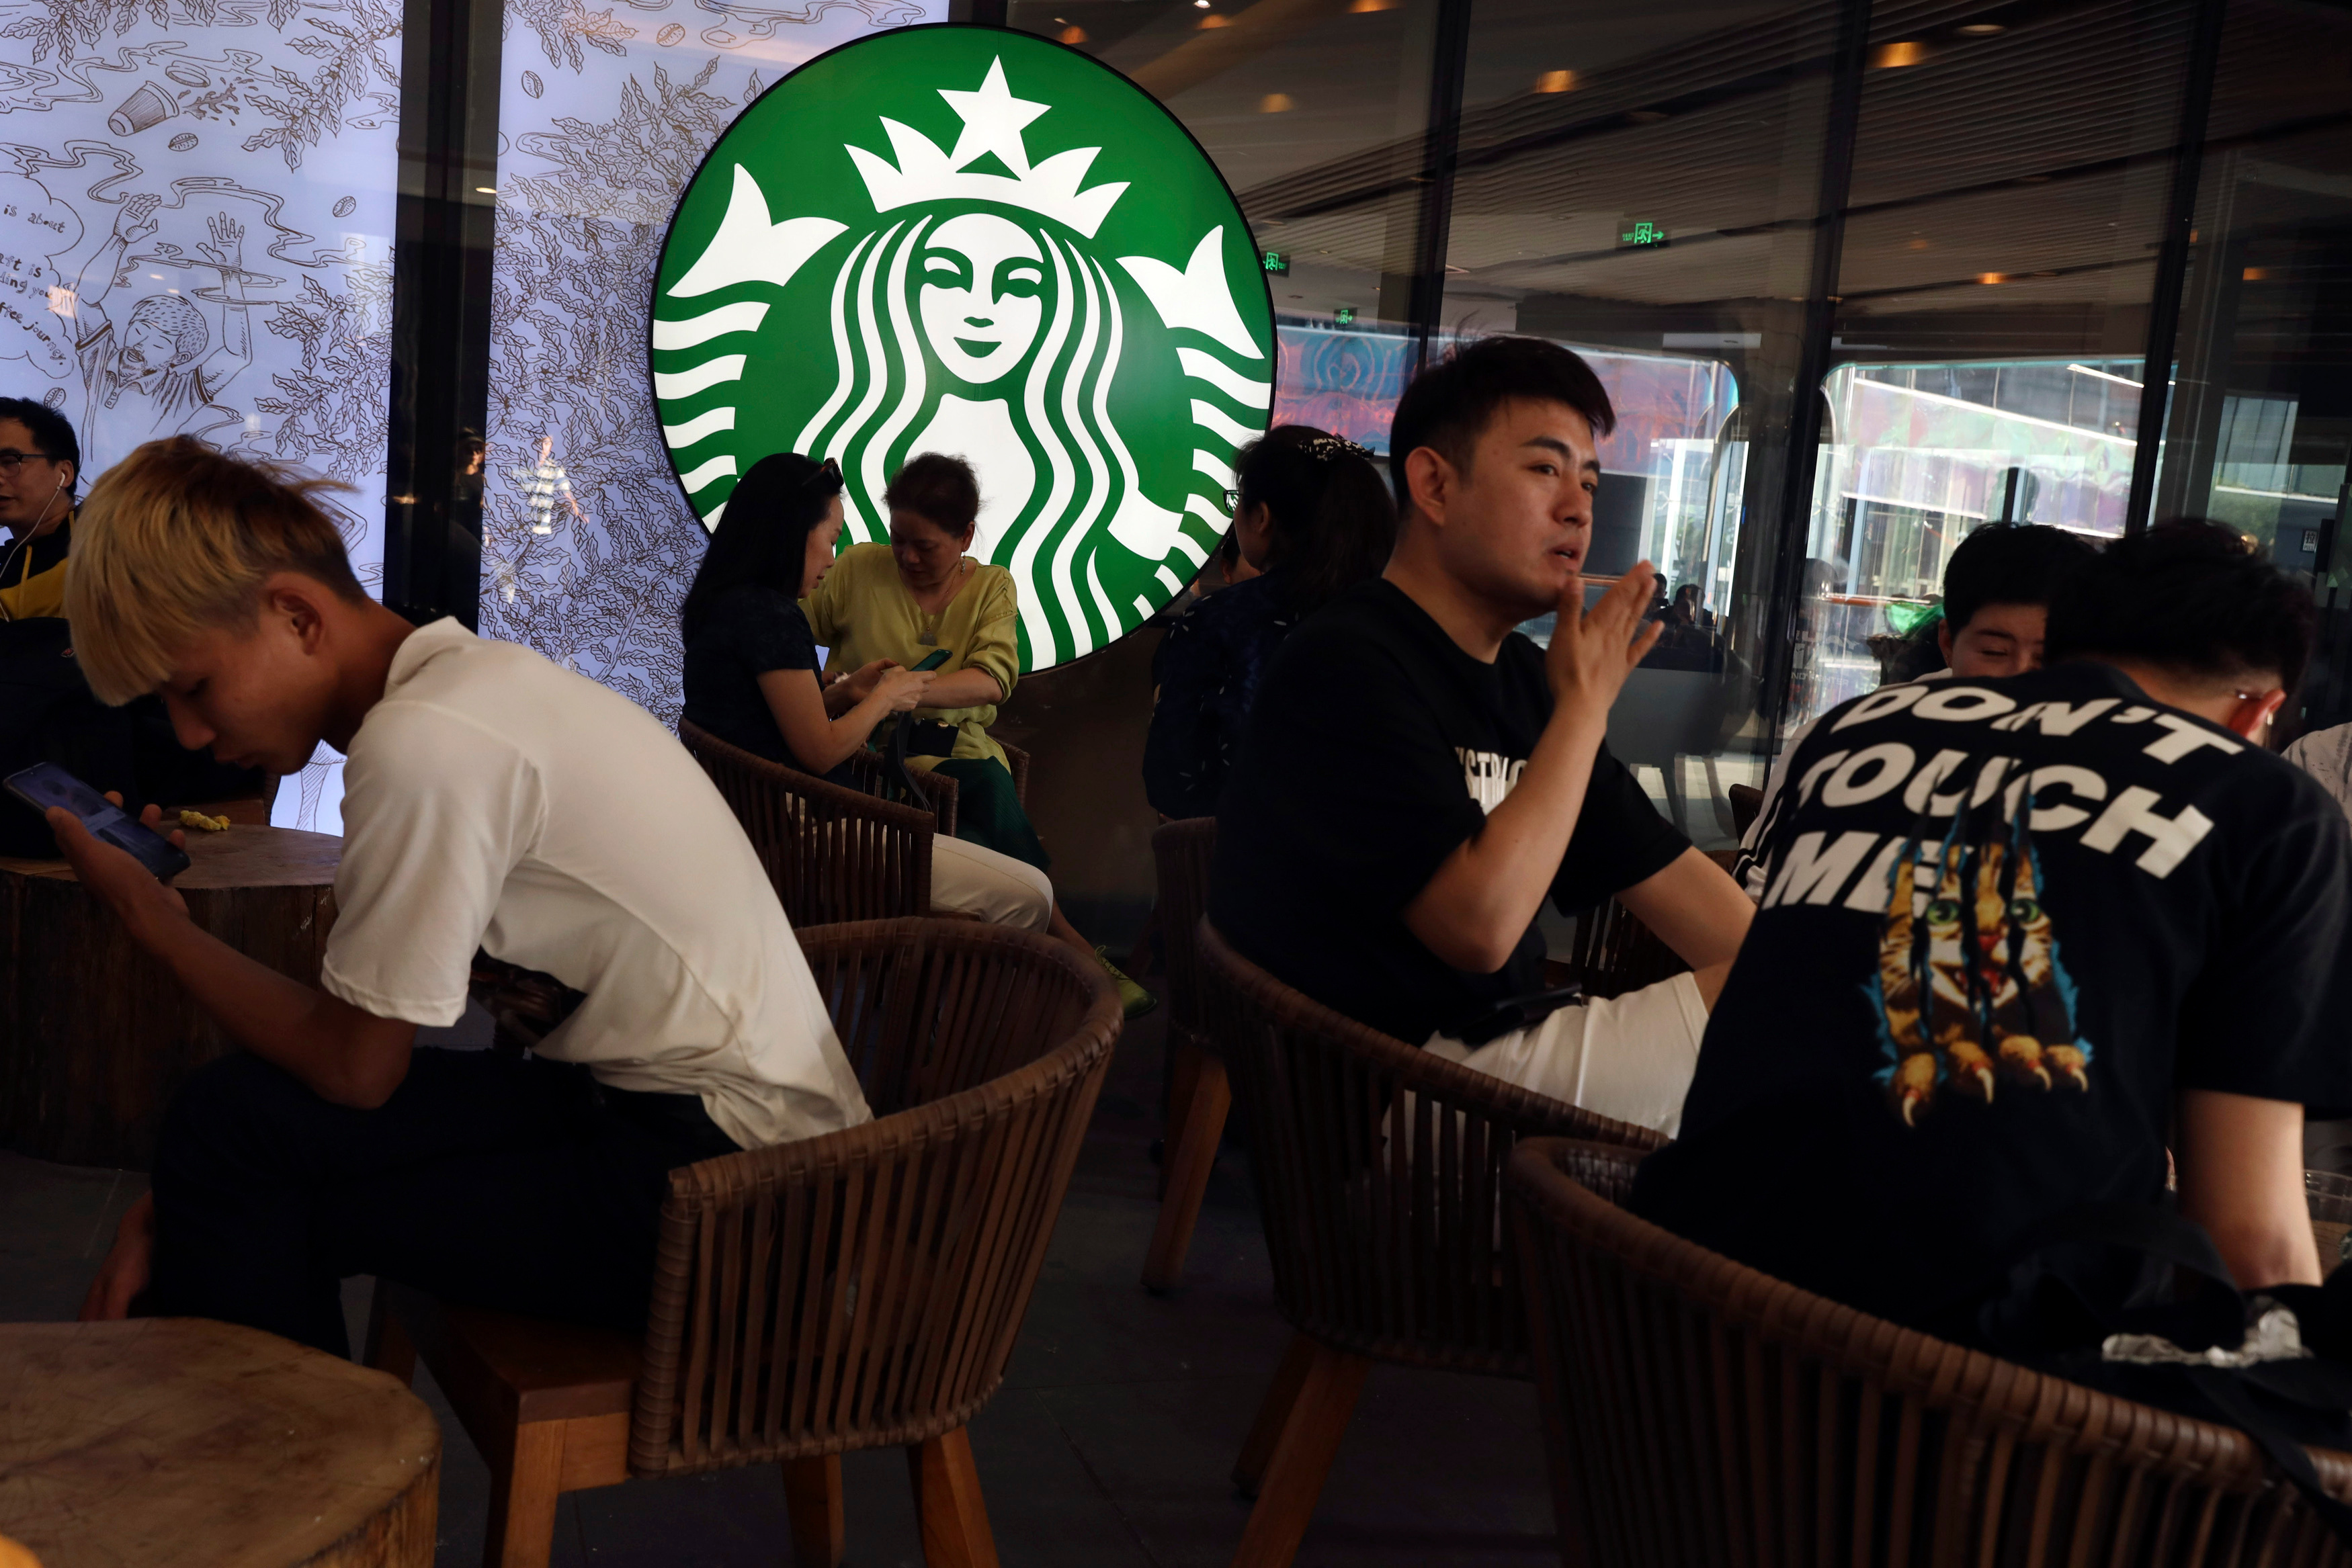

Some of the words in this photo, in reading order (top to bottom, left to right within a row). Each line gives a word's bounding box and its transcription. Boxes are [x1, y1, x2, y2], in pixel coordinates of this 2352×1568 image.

[3, 204, 17, 217] is
[27, 212, 66, 234] about
[28, 263, 42, 278] is
[1830, 686, 2244, 765] DON'T
[1798, 742, 2214, 879] TOUCH
[1761, 830, 1974, 918] ME
